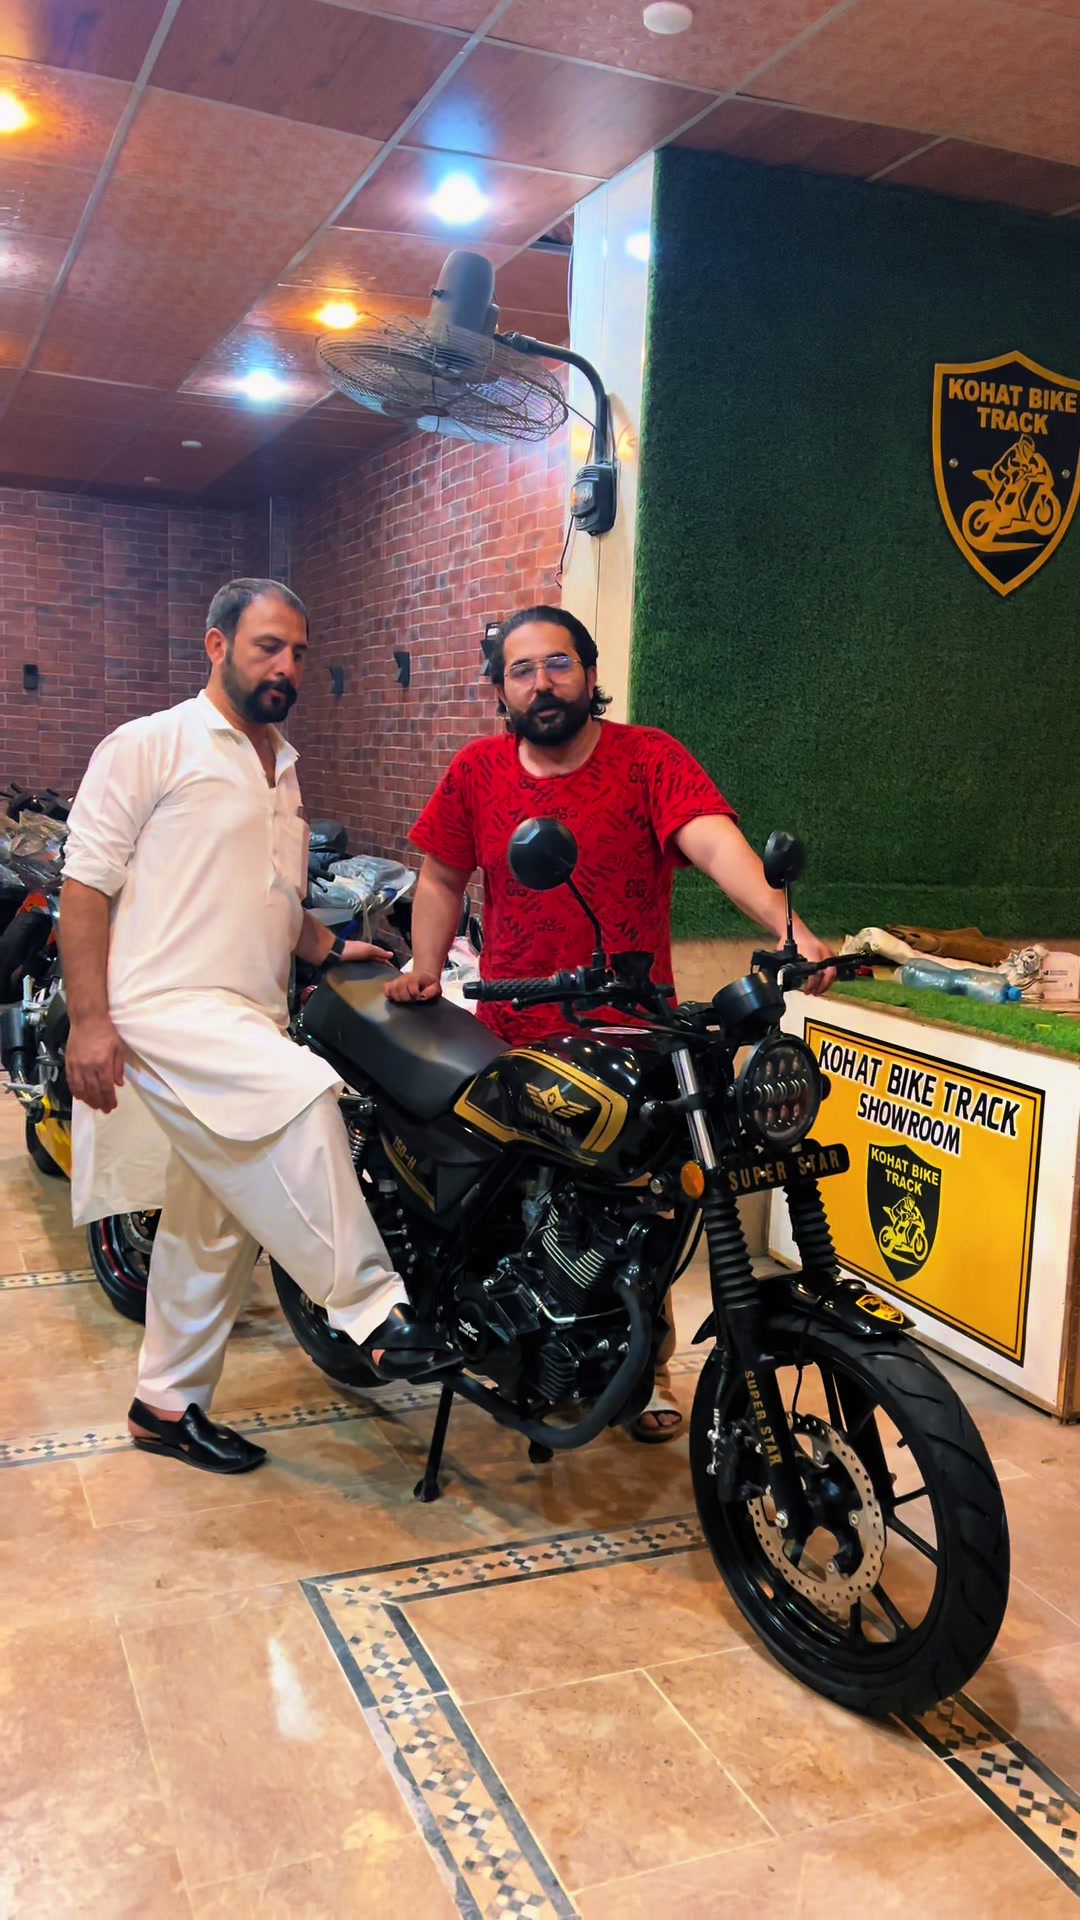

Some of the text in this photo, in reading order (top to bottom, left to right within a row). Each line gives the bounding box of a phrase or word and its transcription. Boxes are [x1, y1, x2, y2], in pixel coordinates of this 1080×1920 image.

[948, 378, 1078, 414] KOHAT BIKE
[977, 406, 1049, 435] TRACK
[818, 1040, 1021, 1137] KOHAT BIKE TRACK
[857, 1092, 961, 1154] SHOWROOM
[728, 1149, 841, 1191] SUPER STAR
[870, 1147, 939, 1186] KOHAT BIKE
[884, 1169, 923, 1196] TRACK
[744, 1370, 783, 1467] SUPER STAR
